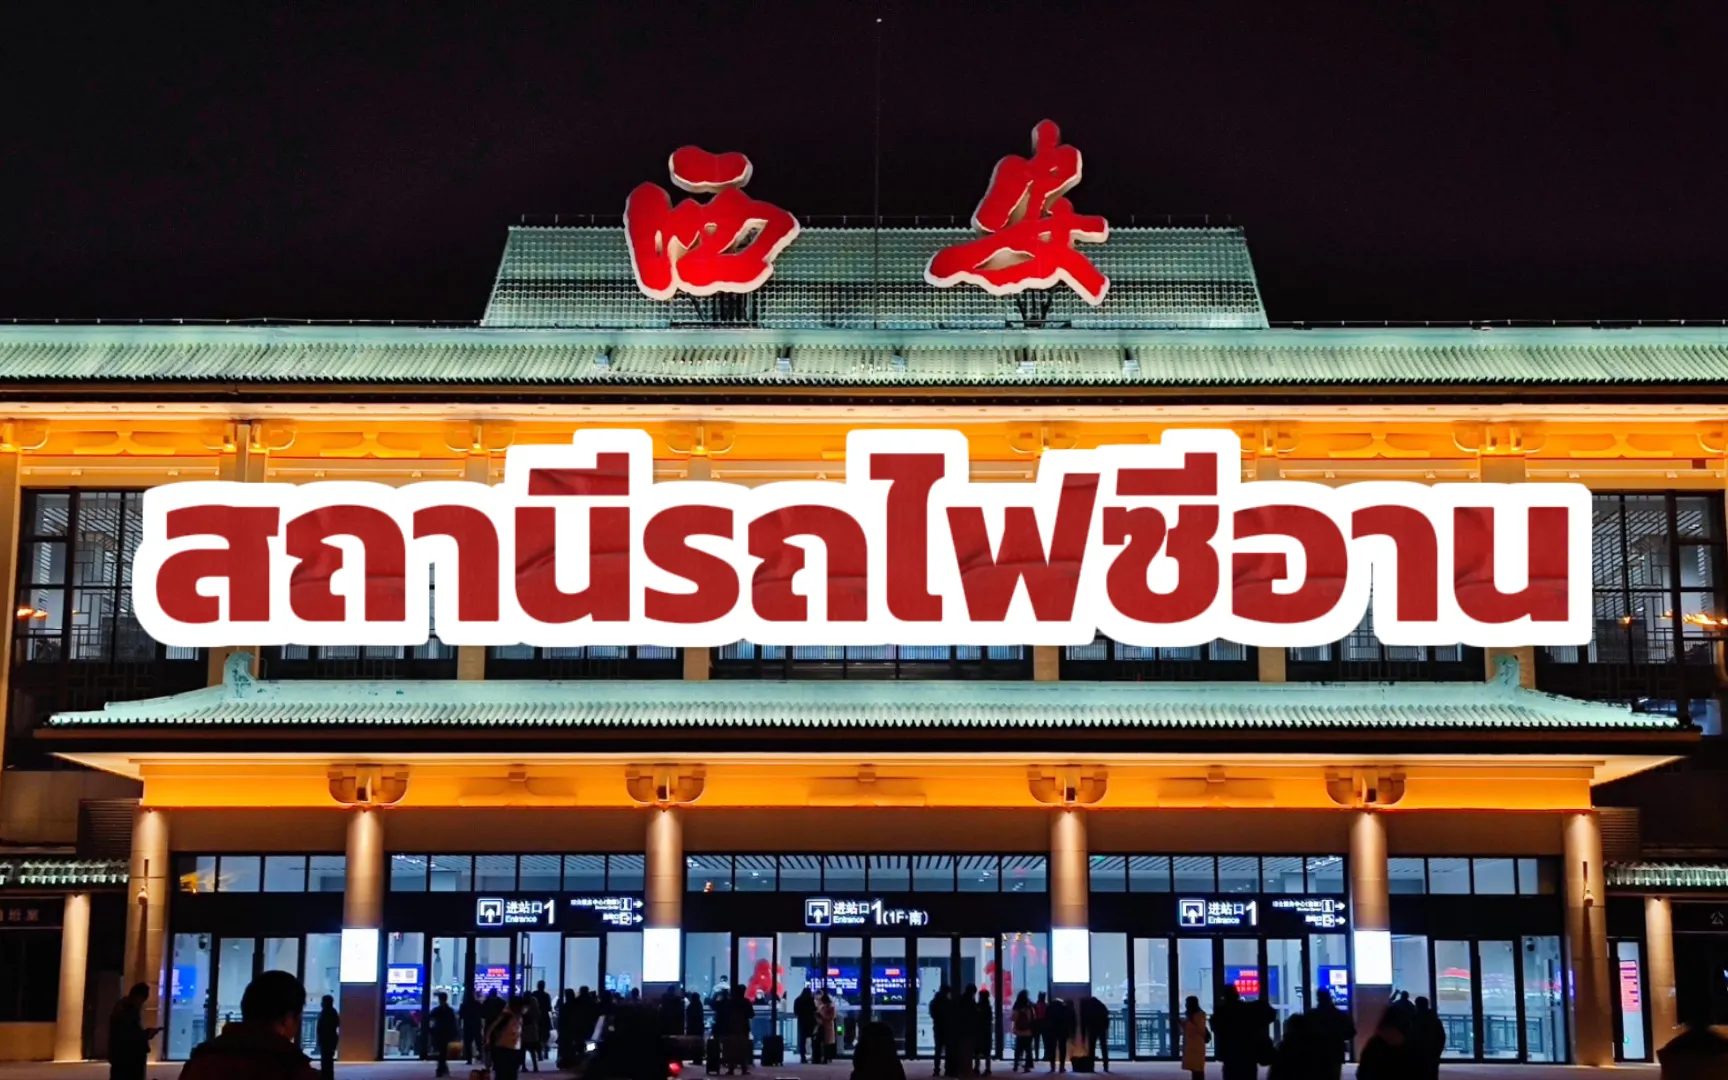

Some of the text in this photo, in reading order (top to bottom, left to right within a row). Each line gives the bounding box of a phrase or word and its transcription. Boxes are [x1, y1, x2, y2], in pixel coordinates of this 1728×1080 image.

[505, 899, 555, 925] 进站口 1
[505, 915, 537, 923] Entrance
[833, 901, 870, 915] 进站口
[871, 900, 883, 925] 1
[833, 916, 865, 924] Entrance
[1207, 900, 1257, 926] 进站口 1
[1207, 916, 1240, 924] Entrance
